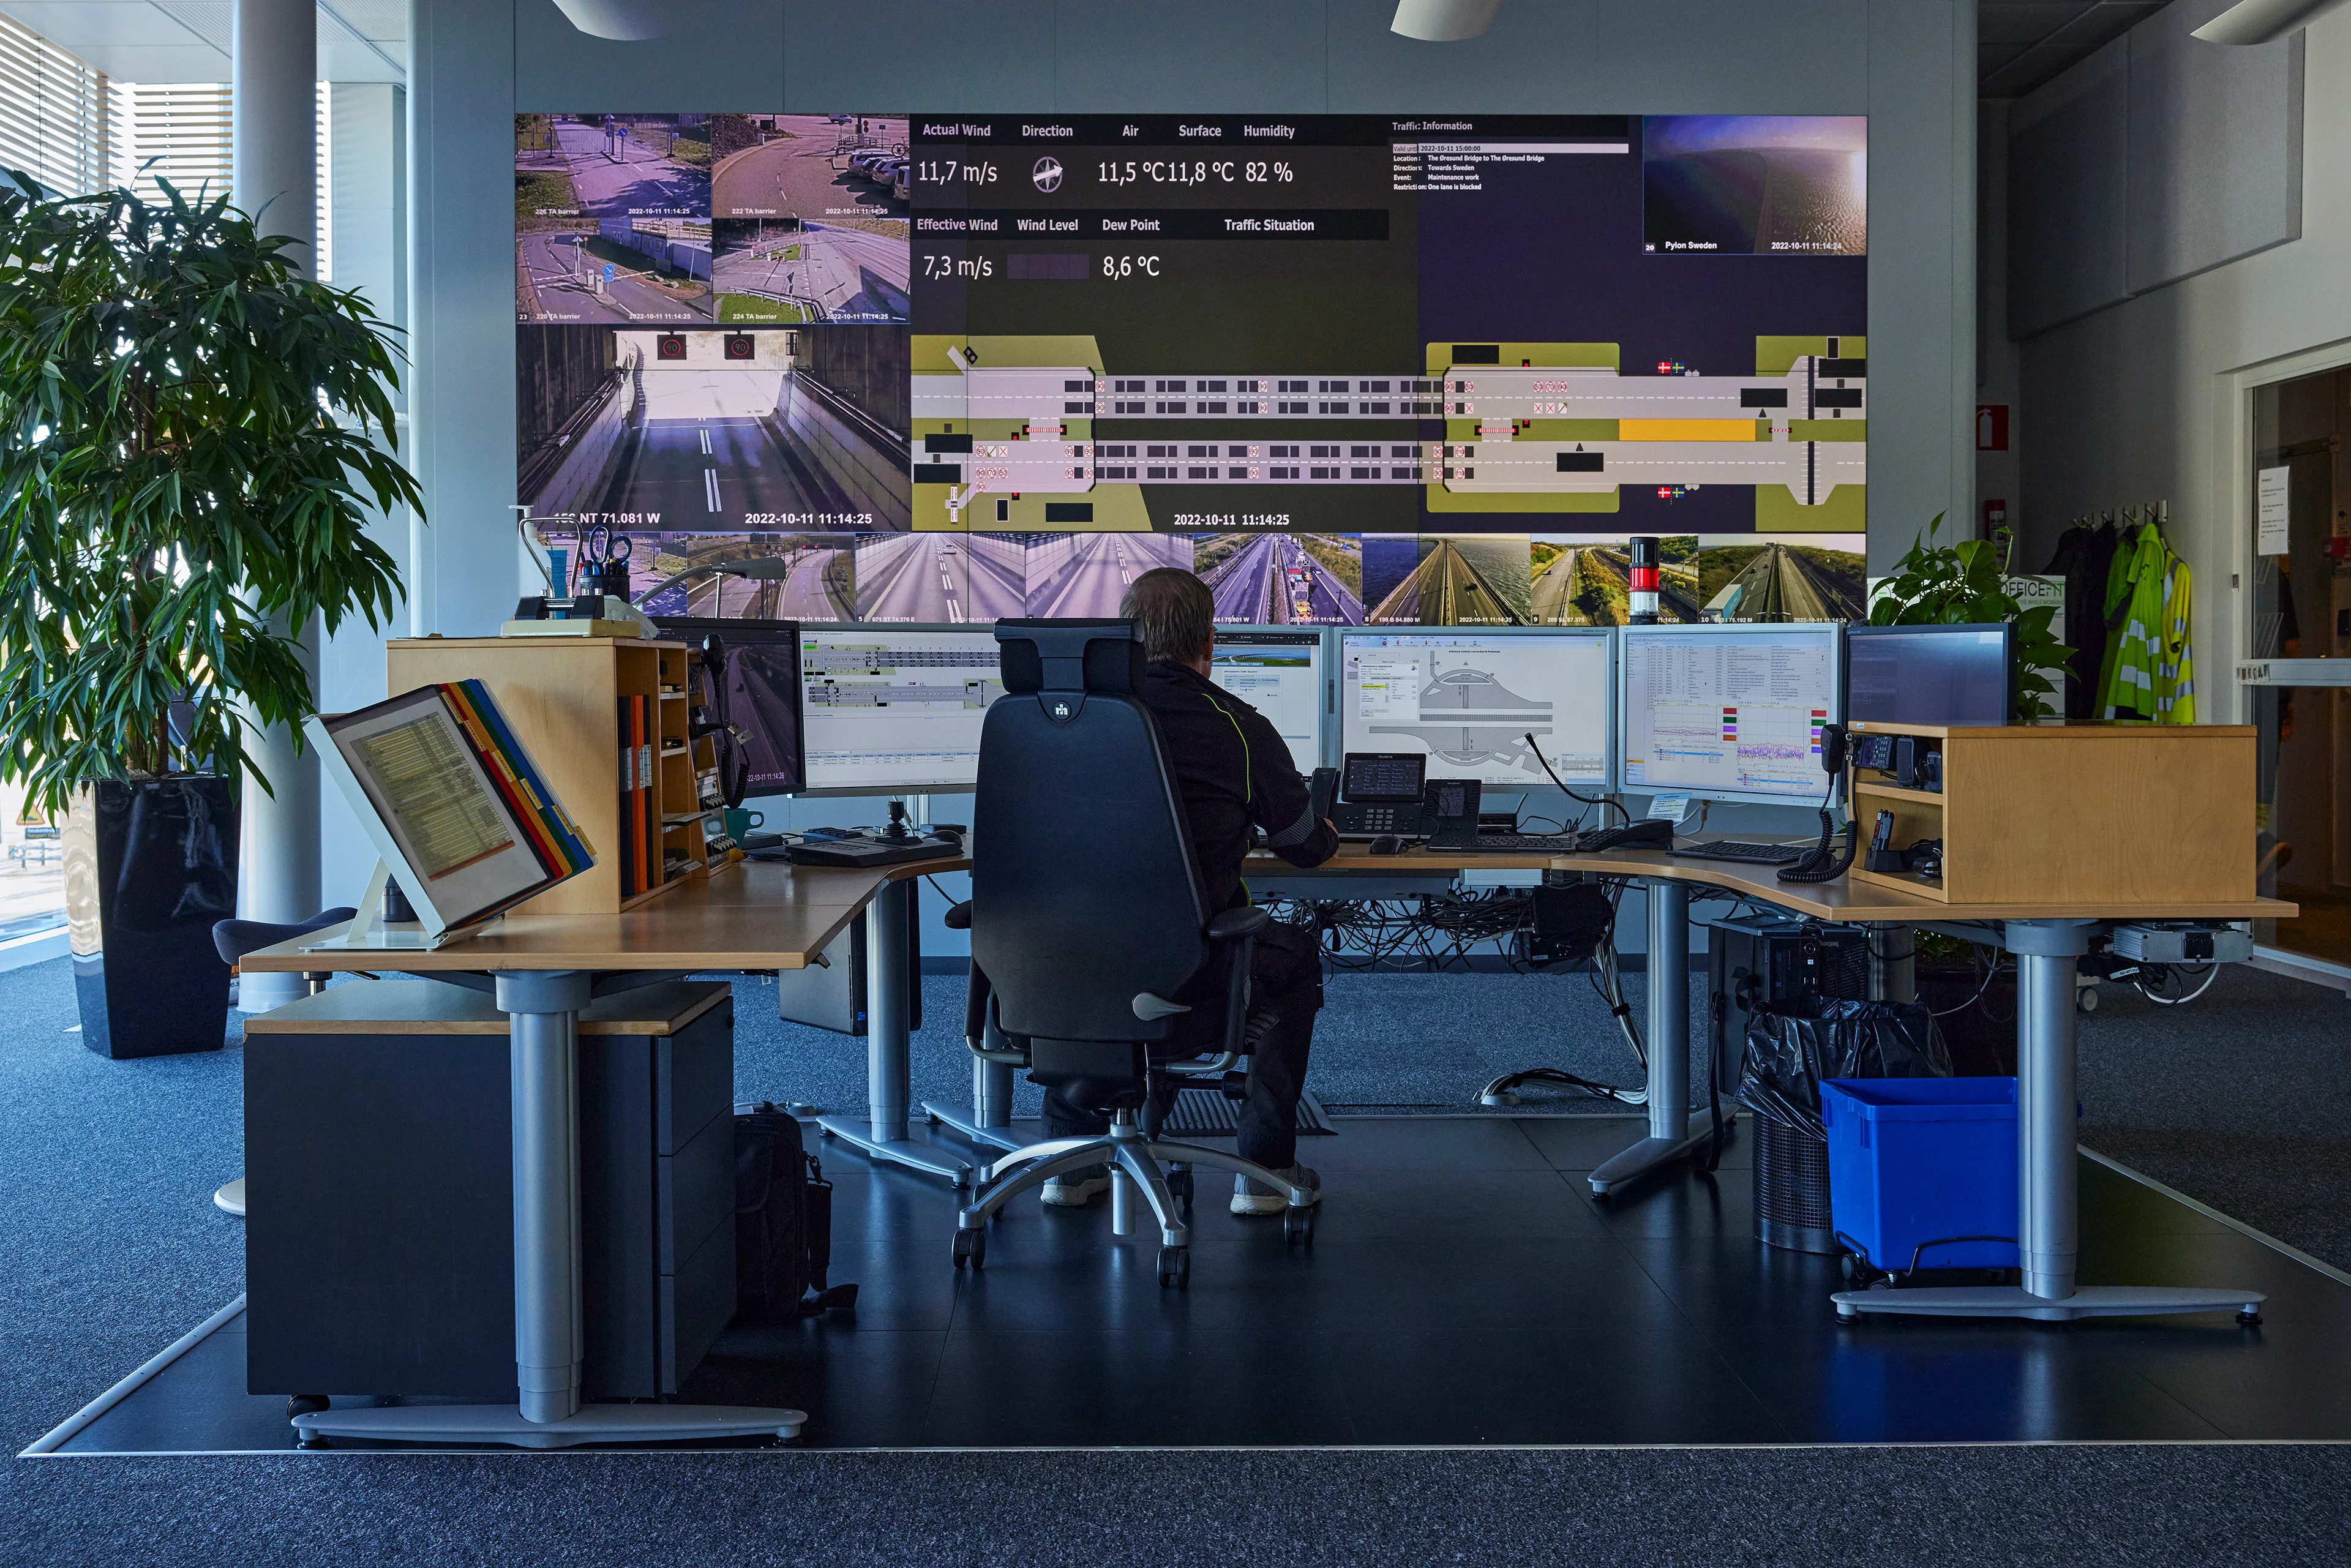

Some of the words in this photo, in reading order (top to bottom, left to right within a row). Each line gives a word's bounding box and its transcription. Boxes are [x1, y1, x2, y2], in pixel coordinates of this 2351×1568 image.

[923, 123, 959, 136] Actual
[962, 124, 991, 137] Wind
[1022, 124, 1073, 137] Direction
[1122, 124, 1139, 137] Air
[1179, 124, 1221, 137] Surface
[1392, 122, 1421, 130] Traffic
[1422, 121, 1472, 130] Information
[1244, 125, 1295, 140] Humidity
[1464, 154, 1482, 163] Bridge
[919, 161, 957, 186] 11,7
[963, 161, 997, 186] m/s
[1099, 162, 1136, 186] 11,5
[1142, 162, 1165, 182] °C
[1168, 162, 1206, 186] 11,8
[1212, 162, 1234, 182] °C
[1245, 162, 1267, 182] 82
[1273, 162, 1293, 182] %
[917, 218, 966, 231] Effective
[969, 219, 998, 231] Wind
[1017, 219, 1046, 231] Wind
[1049, 219, 1078, 231] Level
[1103, 219, 1128, 231] Dew
[1130, 219, 1160, 231] Point
[1224, 219, 1261, 231] Traffic
[1264, 219, 1314, 231] Situation
[1665, 241, 1687, 250] Pylon
[924, 255, 951, 280] 7,3
[958, 255, 992, 280] m/s
[1103, 256, 1131, 280] 8,6
[1138, 256, 1160, 276] °C
[580, 513, 598, 523] NT
[601, 513, 642, 523] 71.081
[647, 513, 661, 523] W
[744, 513, 813, 524] 2022-10-11
[819, 513, 872, 524] 11:14:25
[1181, 513, 1236, 525] 2022-10-11
[1242, 513, 1289, 525] 11:14:25
